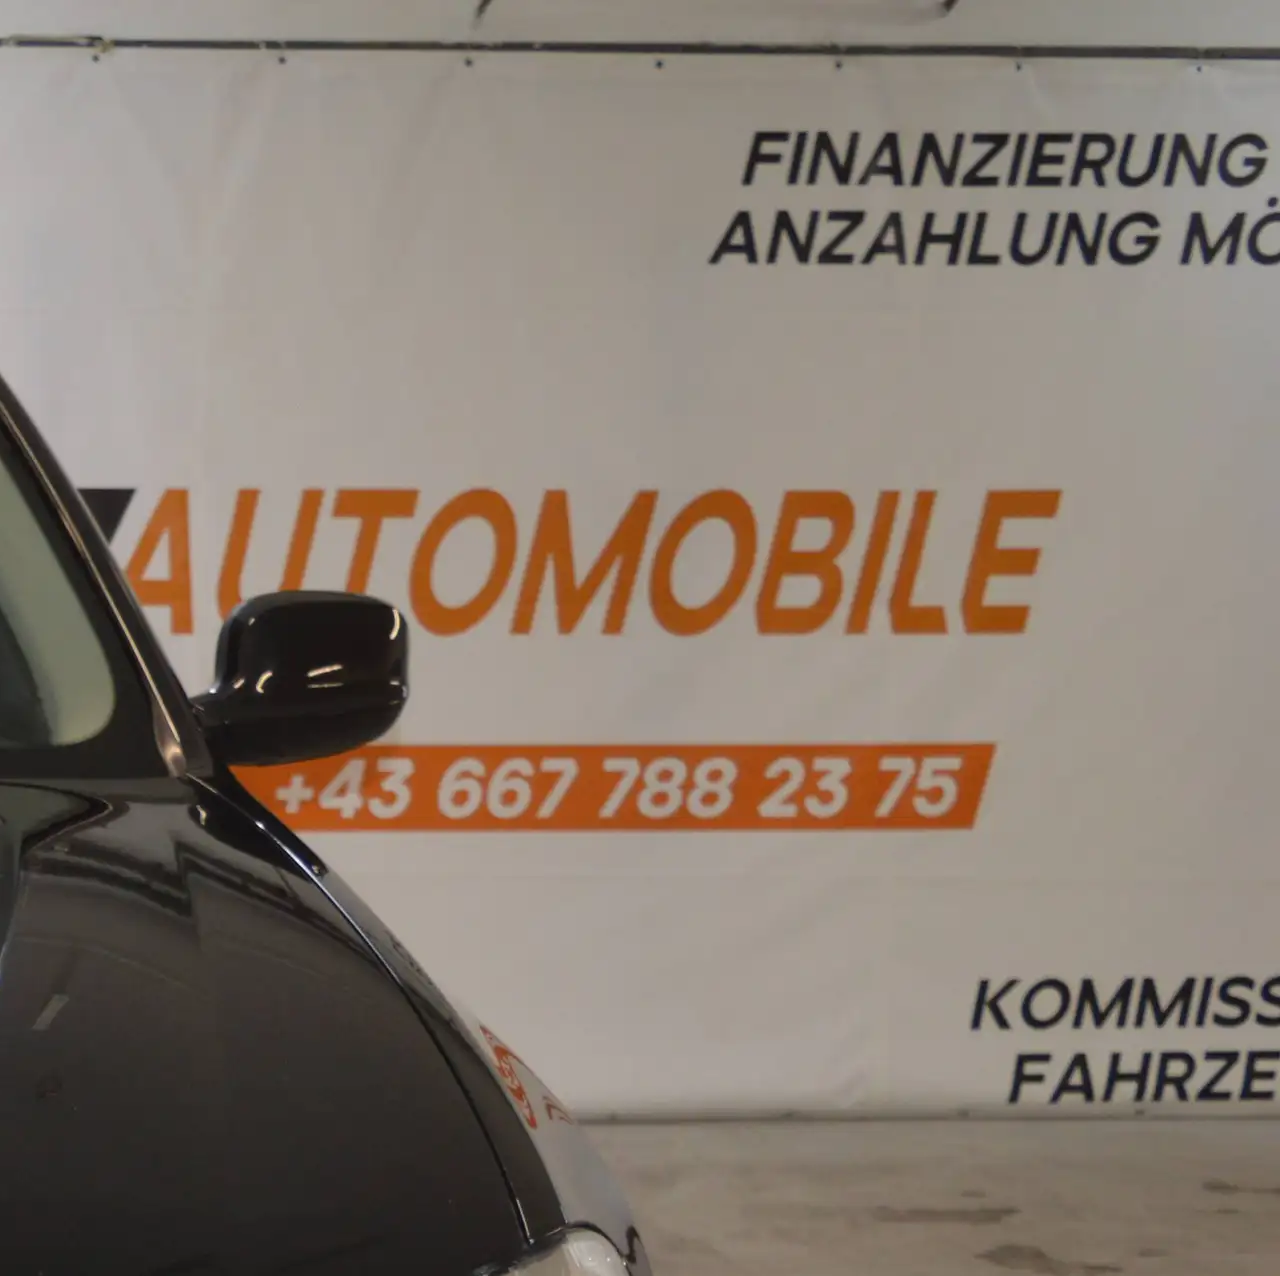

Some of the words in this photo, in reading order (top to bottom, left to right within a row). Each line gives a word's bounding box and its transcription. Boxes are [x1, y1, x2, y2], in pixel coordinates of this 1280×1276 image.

[741, 130, 1268, 188] FINANZIERUNG
[707, 209, 1161, 267] ANZAHLUNG
[124, 488, 1063, 637] AUTOMOBILE
[276, 757, 414, 819] +43
[436, 757, 578, 819] 667
[597, 757, 736, 819] 788
[757, 757, 850, 819] 23
[871, 757, 962, 818] 75
[1008, 1050, 1280, 1104] FAHRZE
